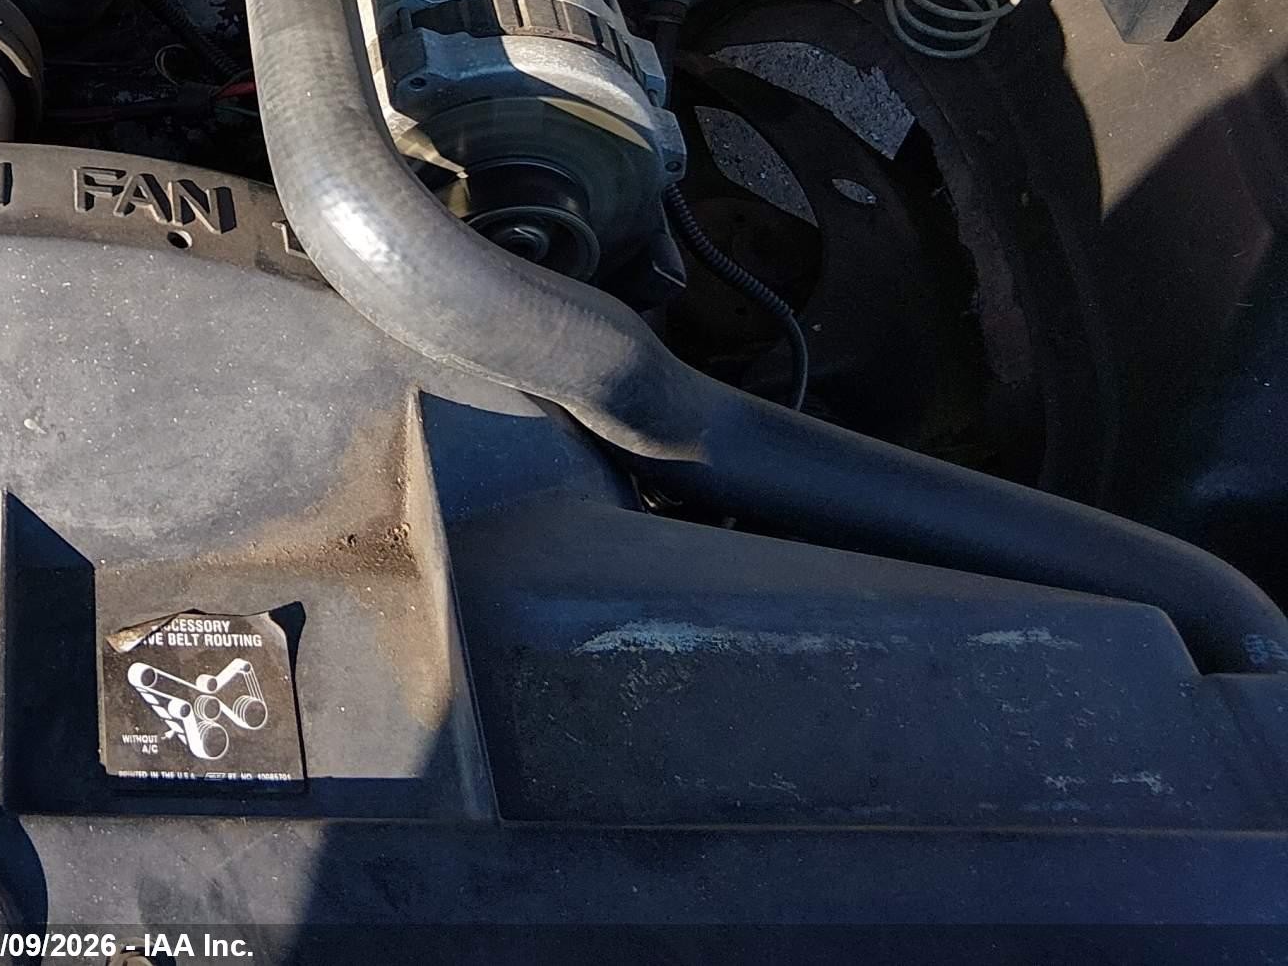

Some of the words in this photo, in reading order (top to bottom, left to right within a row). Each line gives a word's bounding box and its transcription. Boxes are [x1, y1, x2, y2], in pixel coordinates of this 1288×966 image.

[72, 165, 237, 234] FAN
[161, 618, 231, 633] CESSORY
[168, 633, 199, 647] BELT
[204, 634, 263, 648] ROUTING
[122, 734, 158, 744] WITHOUT
[142, 744, 159, 754] A/C
